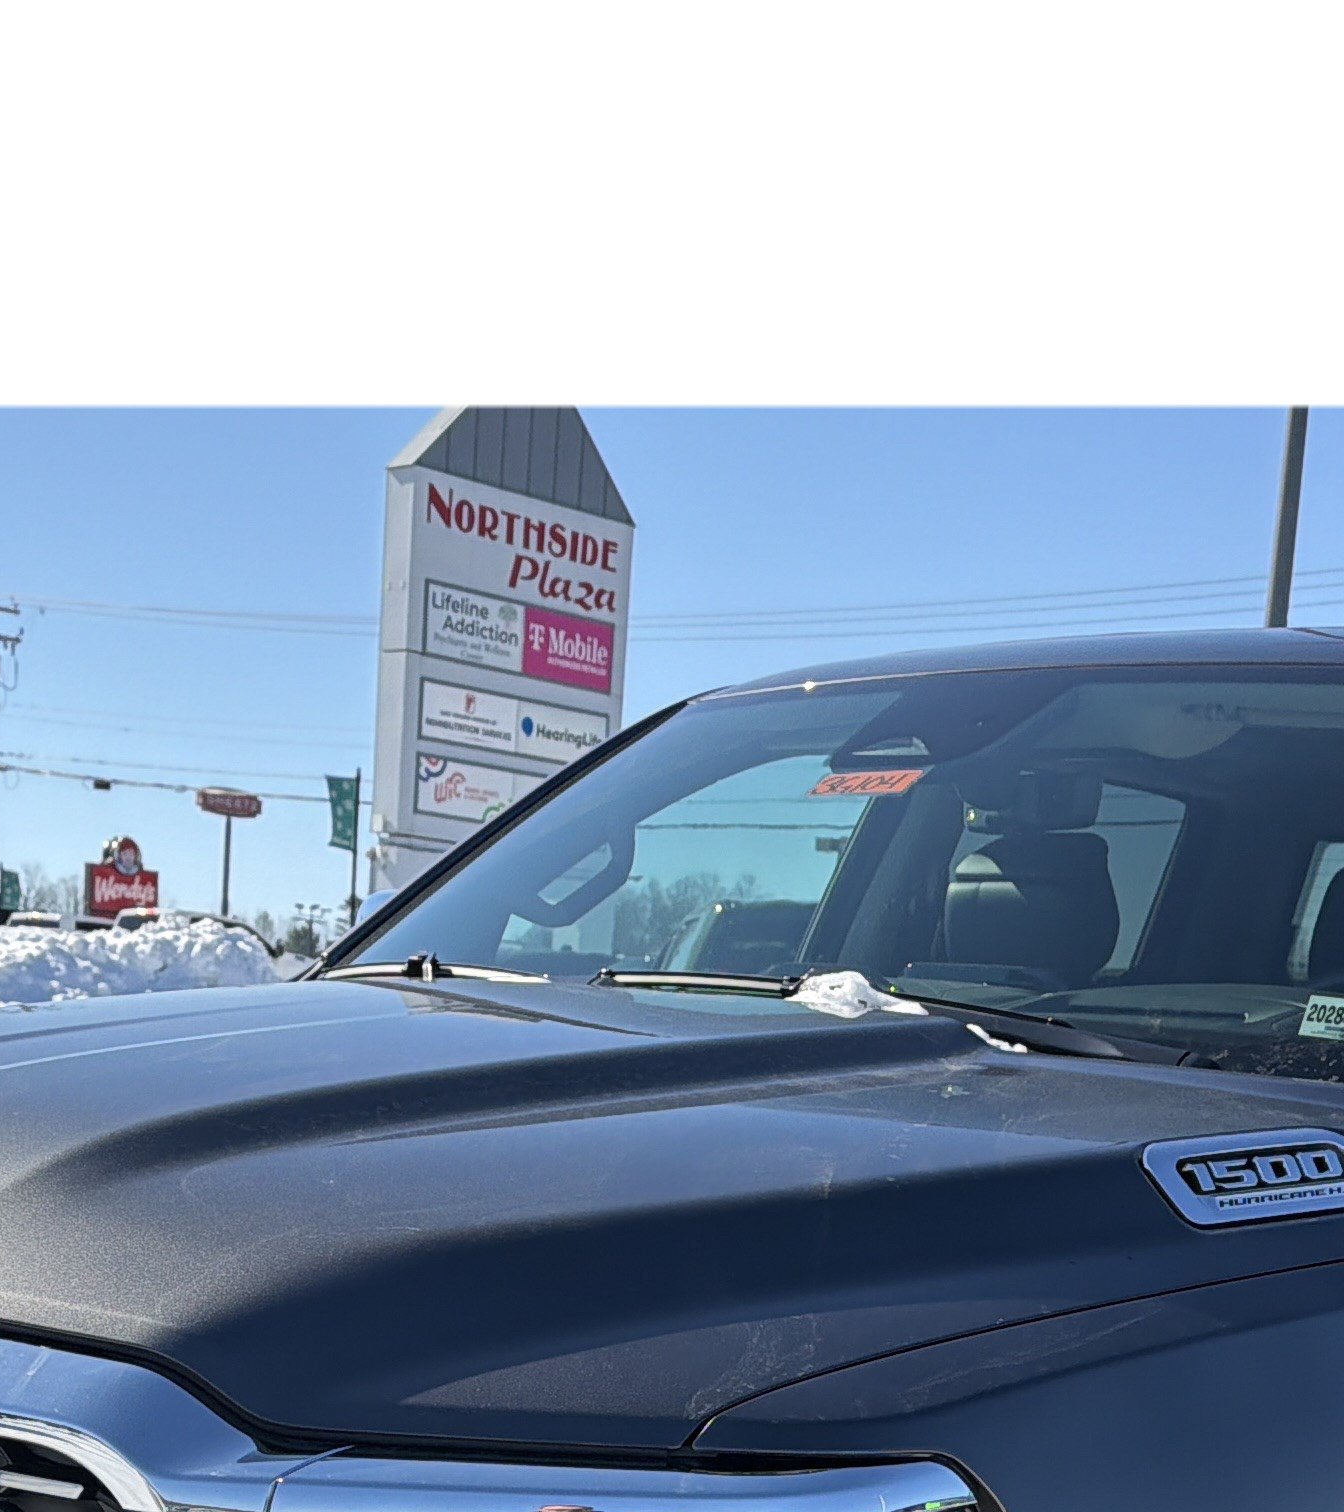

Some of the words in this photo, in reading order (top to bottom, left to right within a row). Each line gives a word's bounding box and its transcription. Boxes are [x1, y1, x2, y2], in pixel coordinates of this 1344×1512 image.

[426, 482, 618, 573] NORTHSIDE
[431, 591, 489, 620] Lifeline
[508, 554, 616, 614] Plaza
[442, 615, 519, 647] Addiction
[1181, 1149, 1344, 1192] 1500
